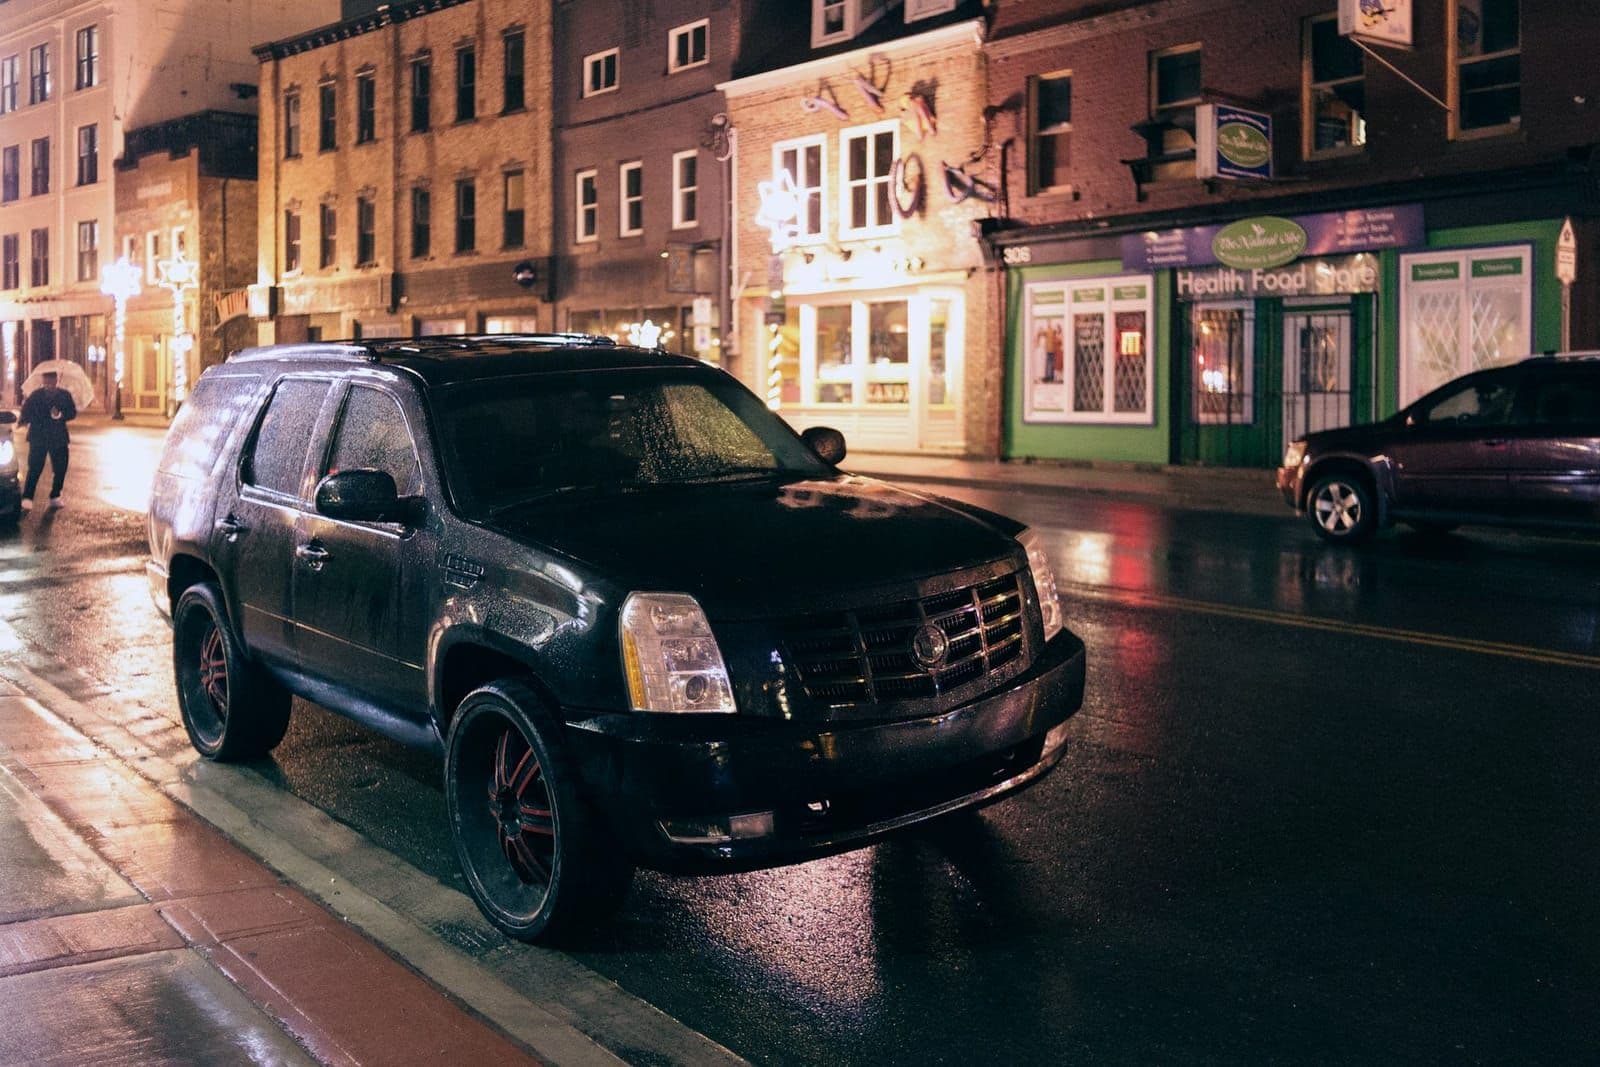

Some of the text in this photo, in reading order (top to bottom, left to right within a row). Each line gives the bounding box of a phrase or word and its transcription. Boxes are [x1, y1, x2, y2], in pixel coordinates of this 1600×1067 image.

[1177, 262, 1376, 295] Health Food Store
